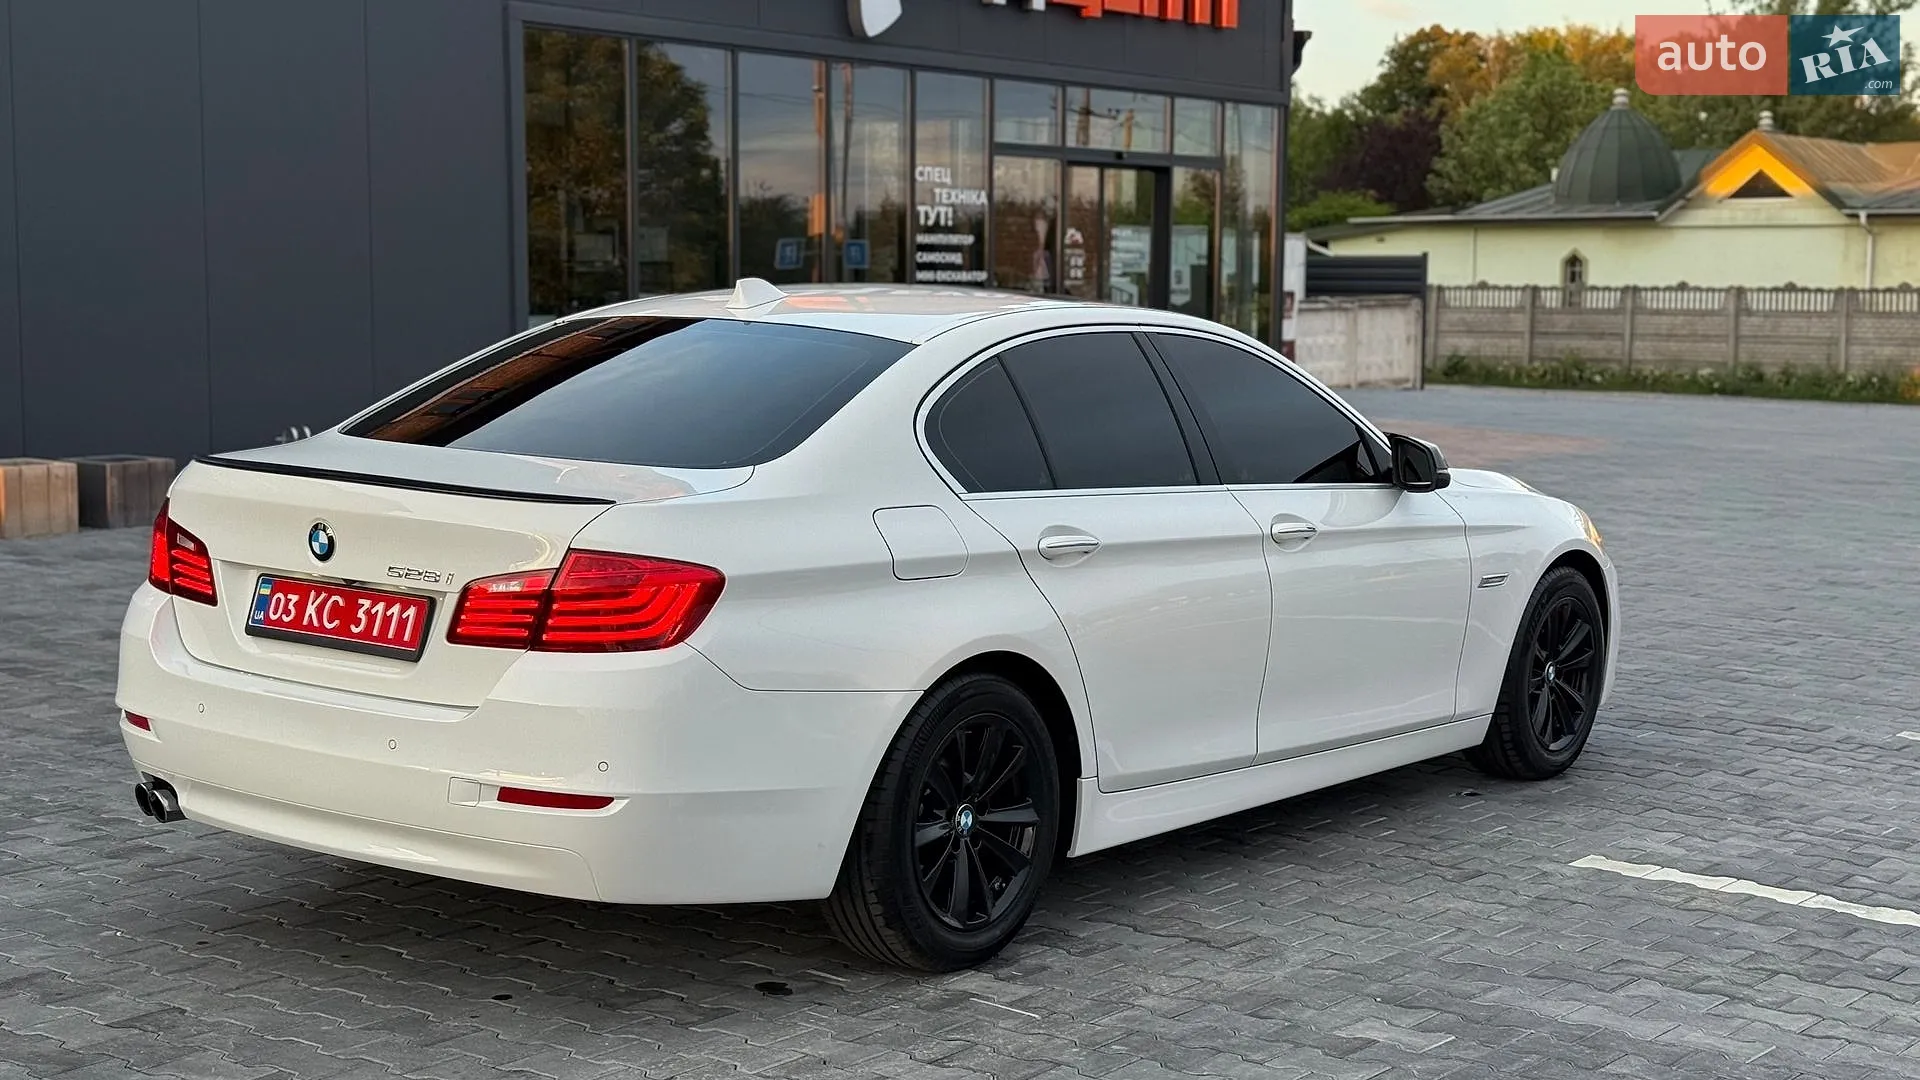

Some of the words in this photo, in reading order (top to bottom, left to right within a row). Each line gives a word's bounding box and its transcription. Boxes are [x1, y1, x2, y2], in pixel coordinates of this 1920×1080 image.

[915, 166, 952, 185] СПЕЦ
[933, 188, 988, 205] ТЕХНІКА
[917, 205, 953, 227] ТУТ!
[254, 610, 265, 621] UA
[268, 592, 300, 623] 03
[302, 590, 345, 629] KC
[350, 598, 418, 642] 3111
